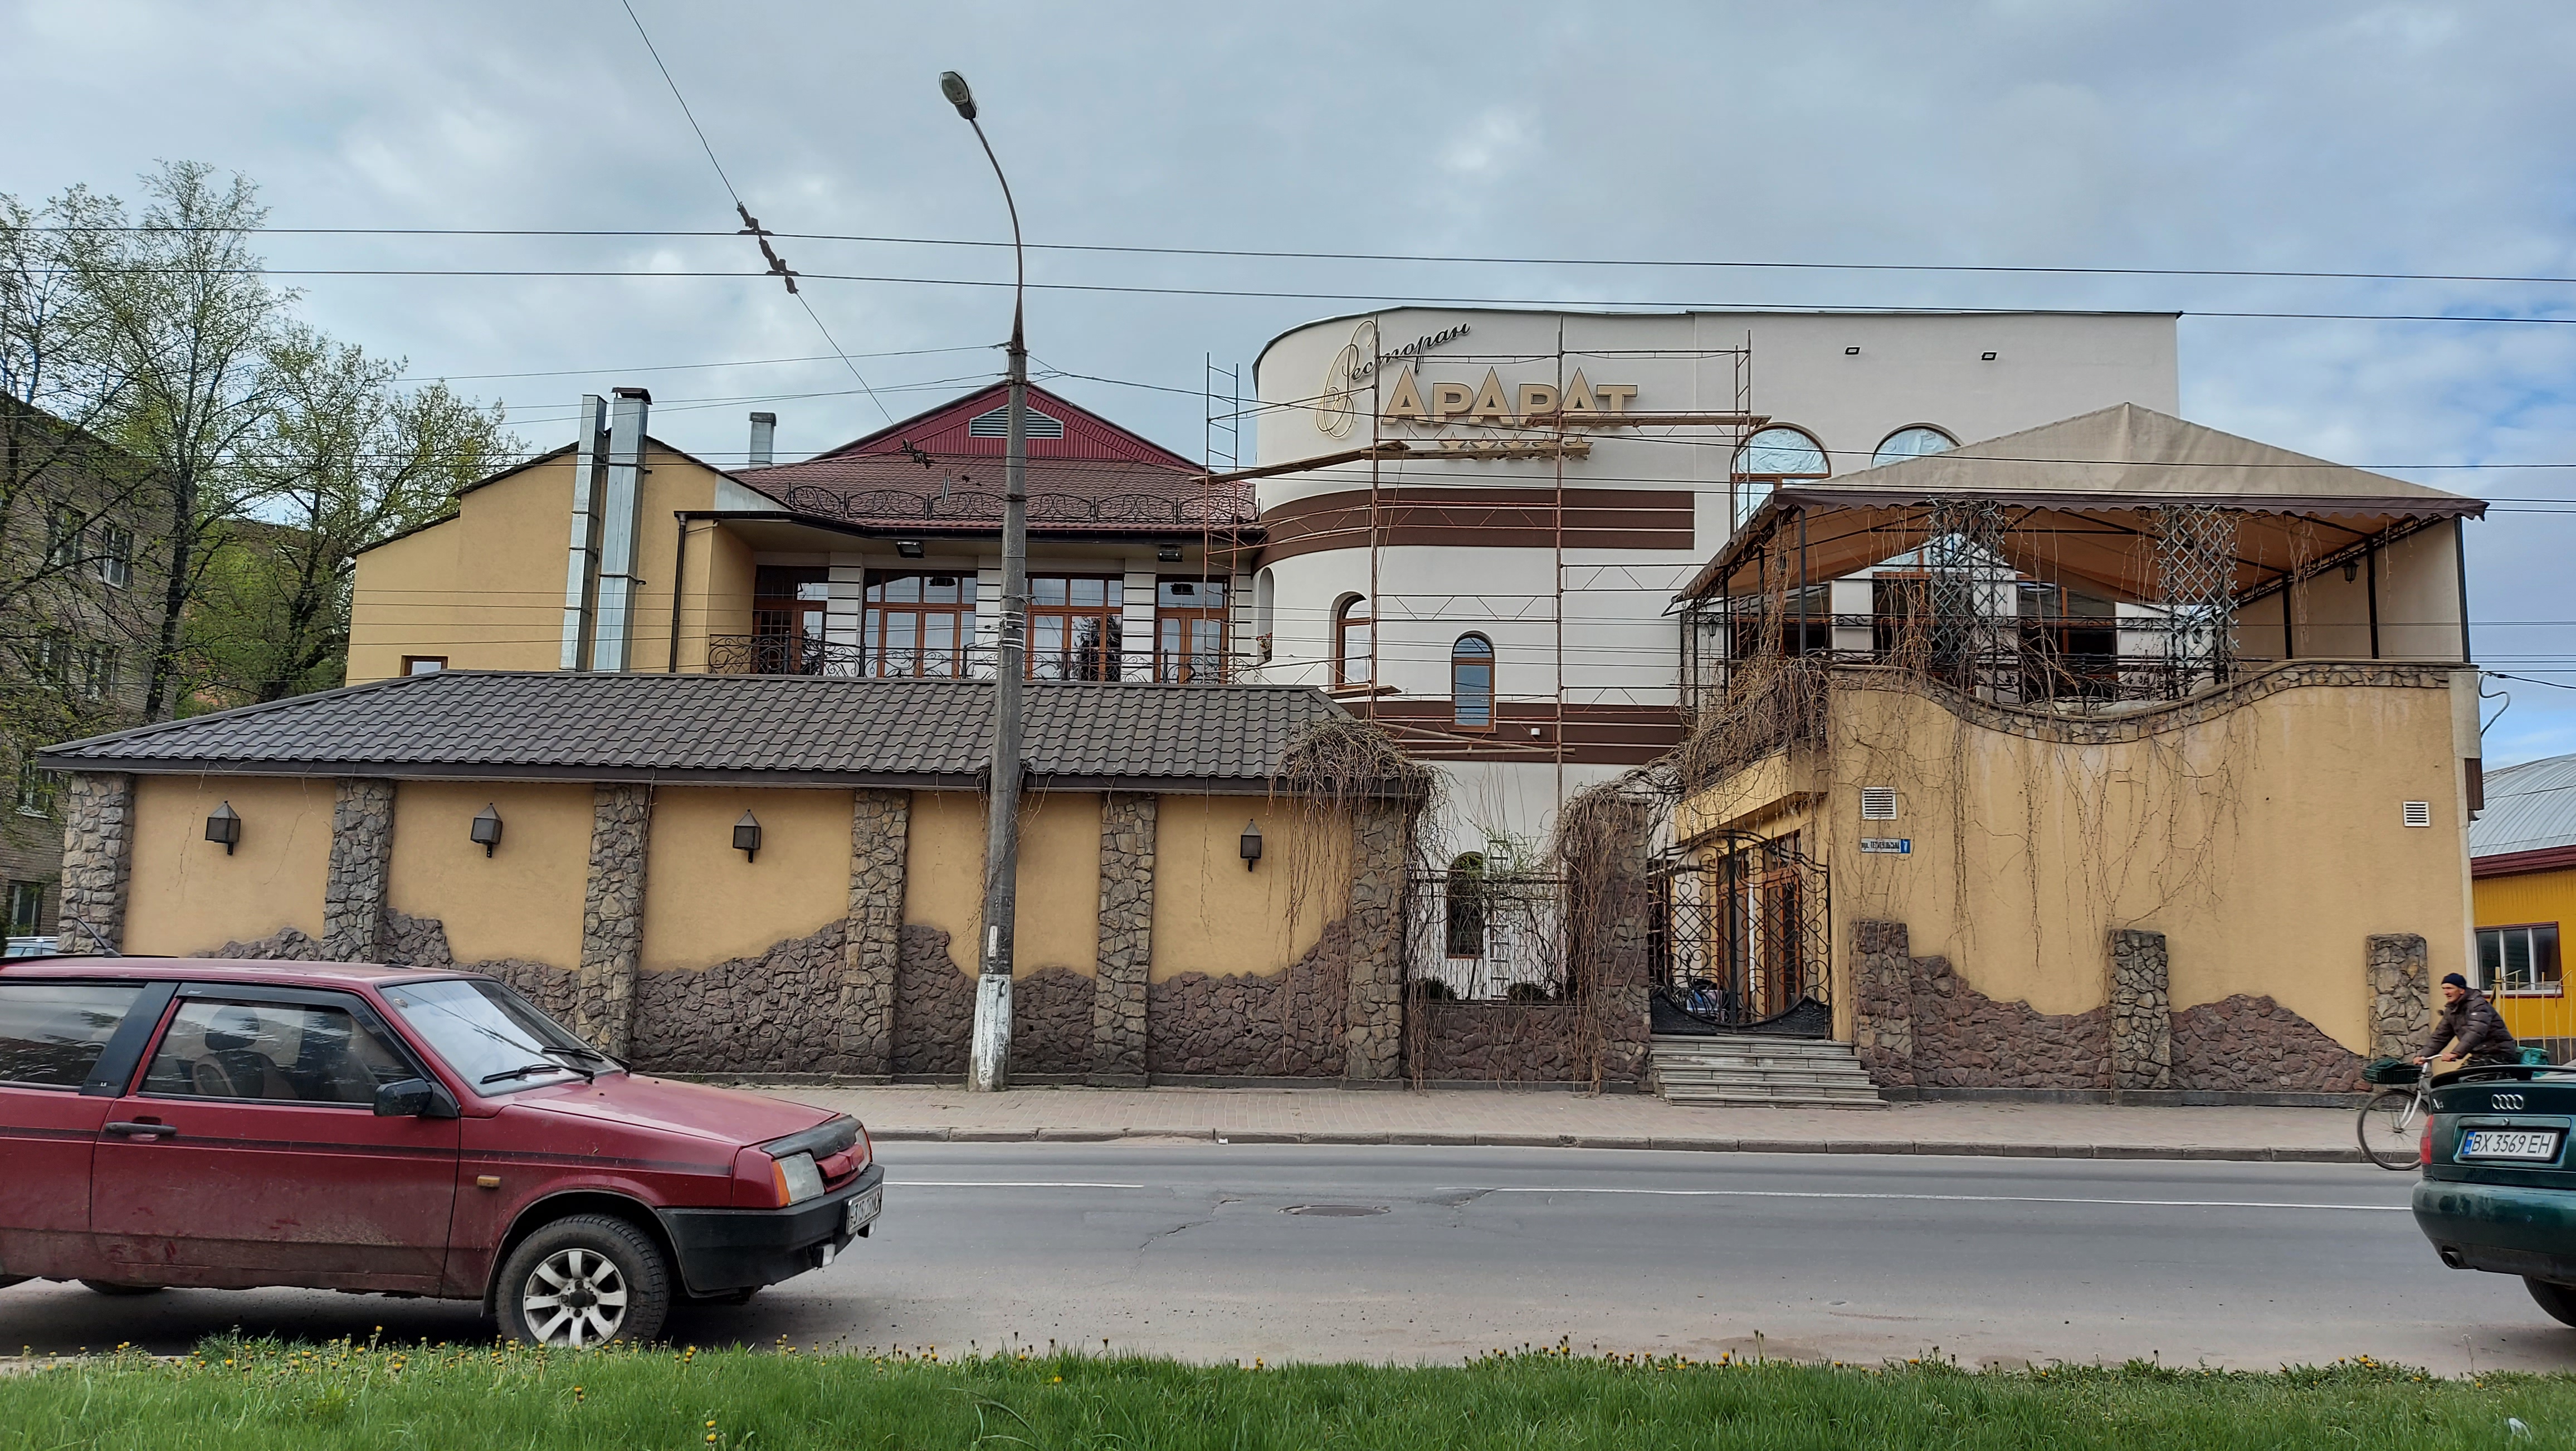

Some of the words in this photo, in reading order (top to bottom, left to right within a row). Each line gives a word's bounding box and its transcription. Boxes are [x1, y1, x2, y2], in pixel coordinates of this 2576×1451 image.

[1382, 365, 1637, 425] АРАРАТ
[2471, 1134, 2492, 1152] BX
[2493, 1134, 2526, 1153] 3569
[2527, 1135, 2552, 1154] EH
